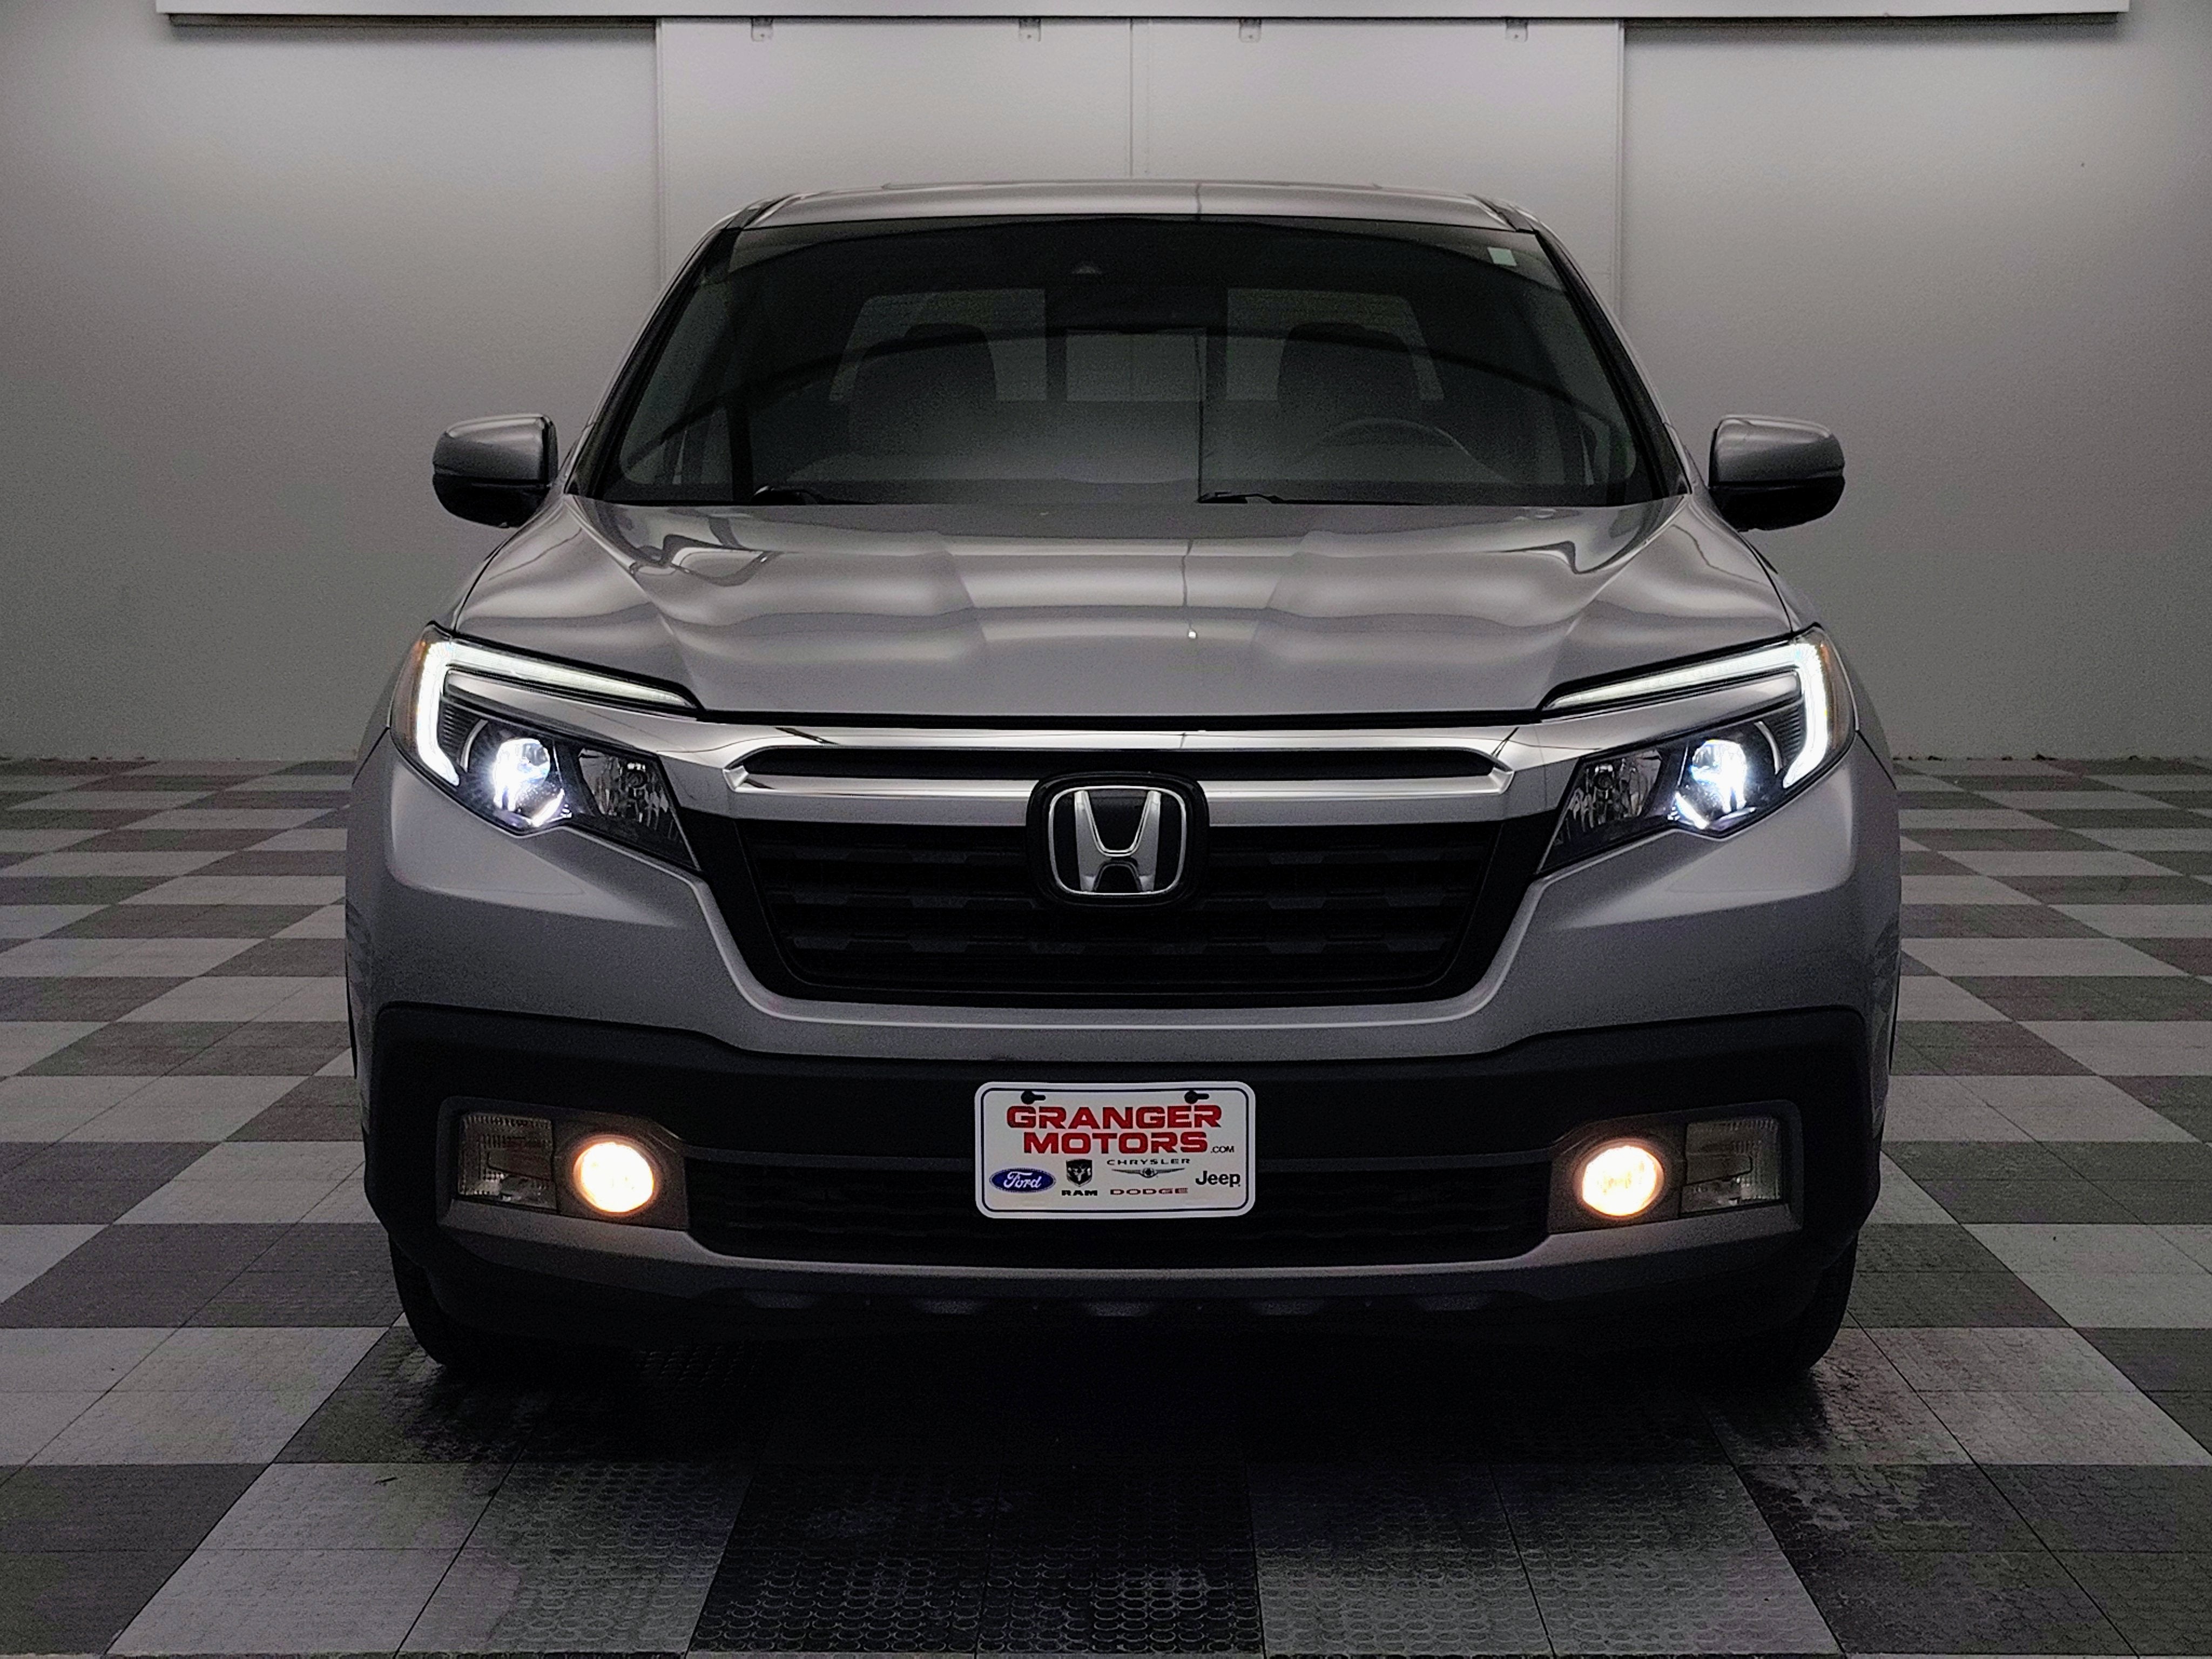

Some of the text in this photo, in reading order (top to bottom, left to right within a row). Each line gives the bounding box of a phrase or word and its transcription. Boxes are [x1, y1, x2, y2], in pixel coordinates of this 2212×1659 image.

[1007, 1105, 1222, 1129] GRANGER
[1023, 1131, 1208, 1154] MOTORS
[1003, 1171, 1043, 1189] Ford
[1195, 1170, 1240, 1187] Jeep
